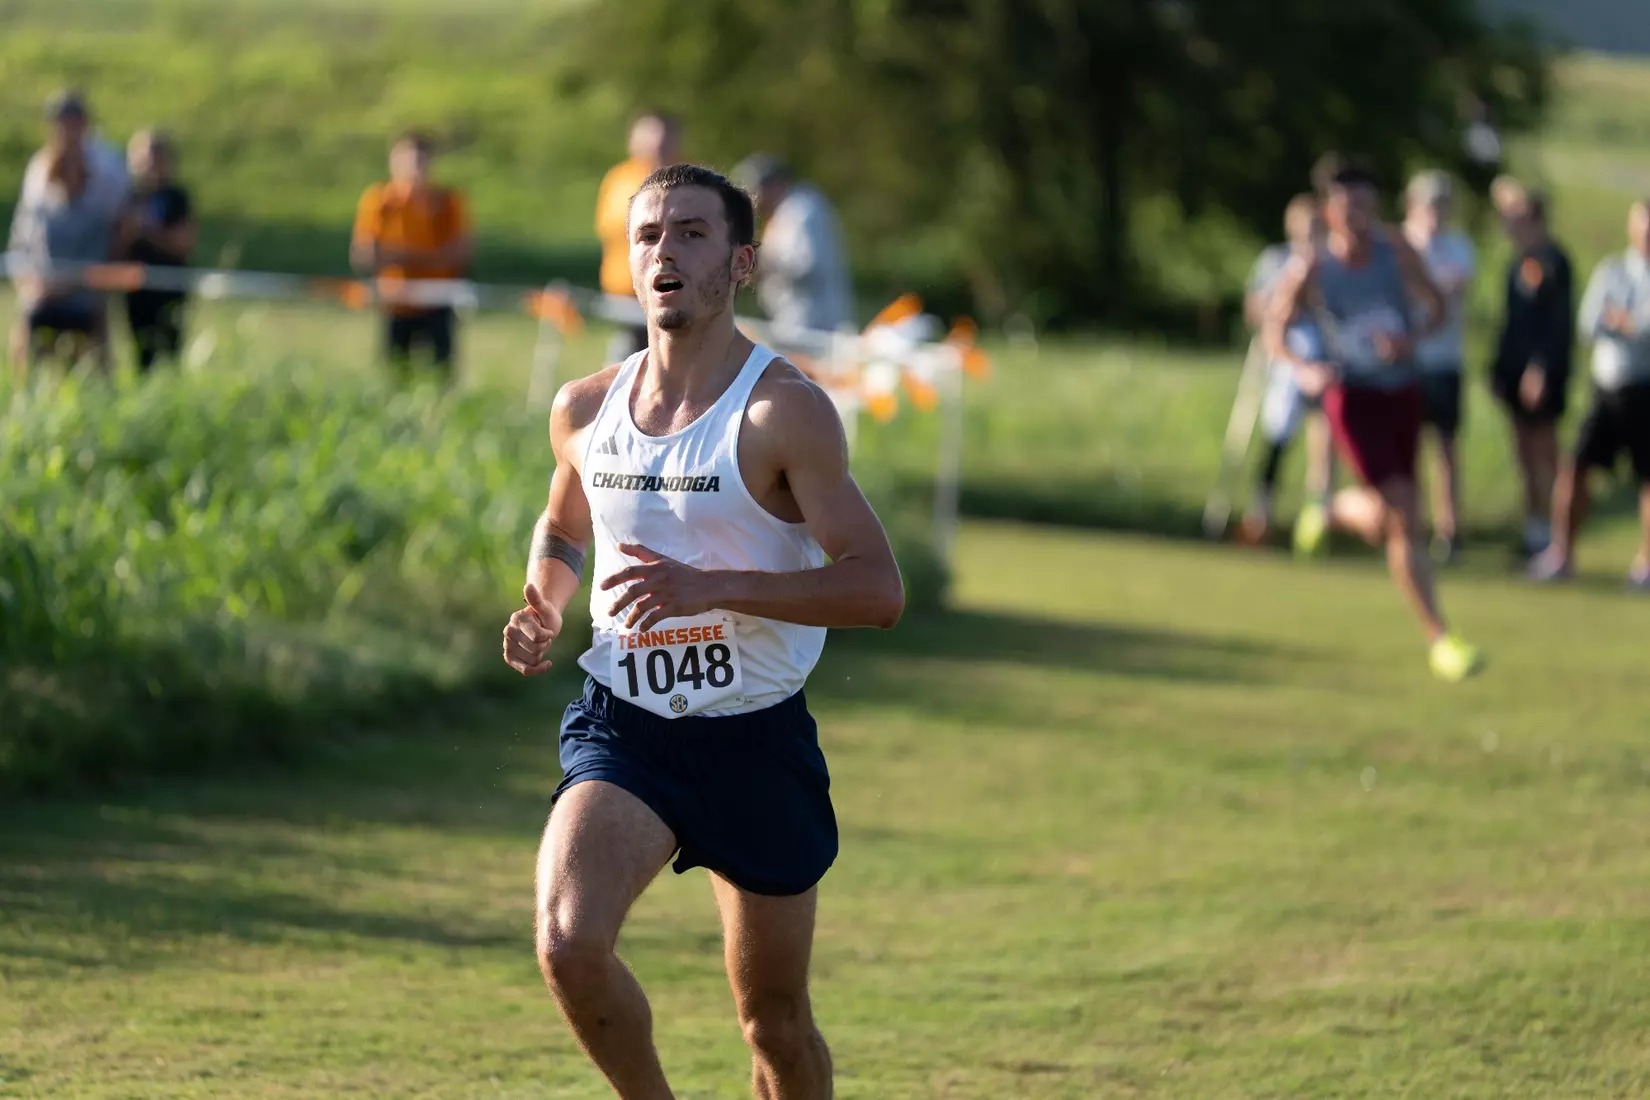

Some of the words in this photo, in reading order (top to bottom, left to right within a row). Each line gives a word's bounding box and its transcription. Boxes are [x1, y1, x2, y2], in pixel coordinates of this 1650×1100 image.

[593, 472, 720, 492] CHATTANOOGA
[618, 624, 725, 650] TENNESSEE
[618, 643, 734, 697] 1048
[670, 695, 688, 712] SEC
